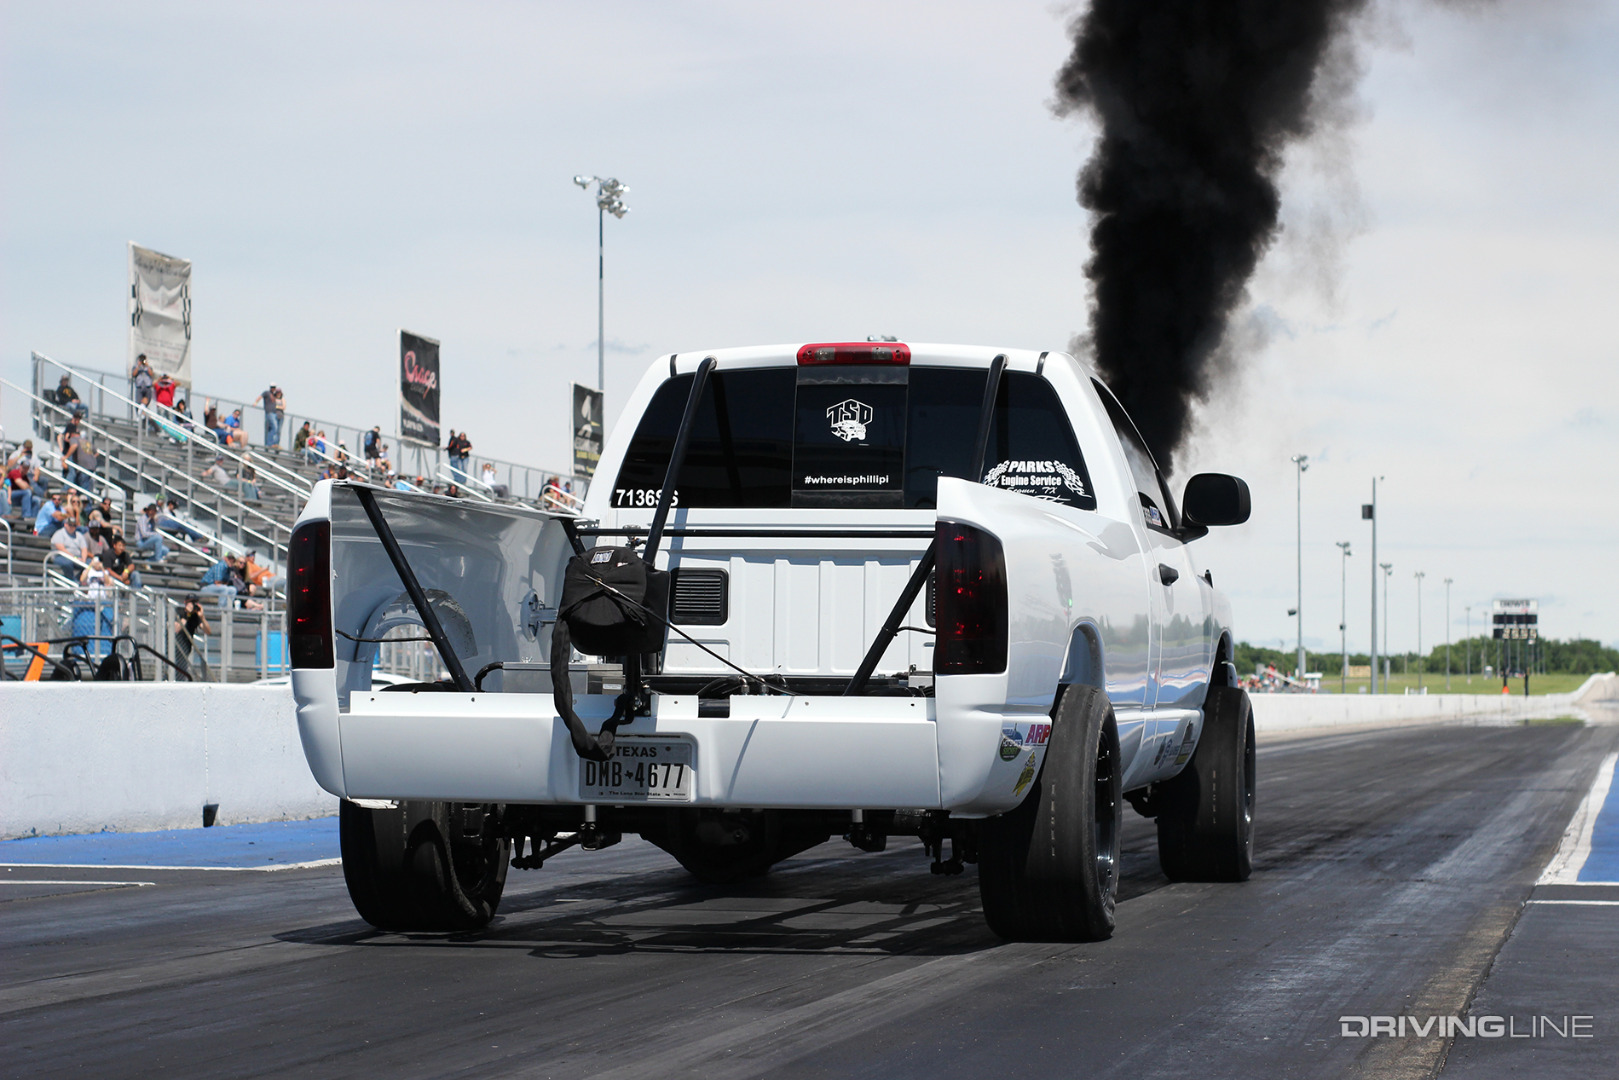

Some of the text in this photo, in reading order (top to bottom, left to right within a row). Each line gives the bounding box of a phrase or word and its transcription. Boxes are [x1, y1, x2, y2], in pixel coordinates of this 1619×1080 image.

[1007, 460, 1055, 473] PARKS
[804, 474, 889, 485] #whereisphillipi
[1001, 475, 1062, 487] Engine Service
[1042, 486, 1057, 494] TX
[1025, 724, 1051, 743] ARP
[615, 746, 657, 757] TEXAS
[586, 761, 685, 789] DMB 4677
